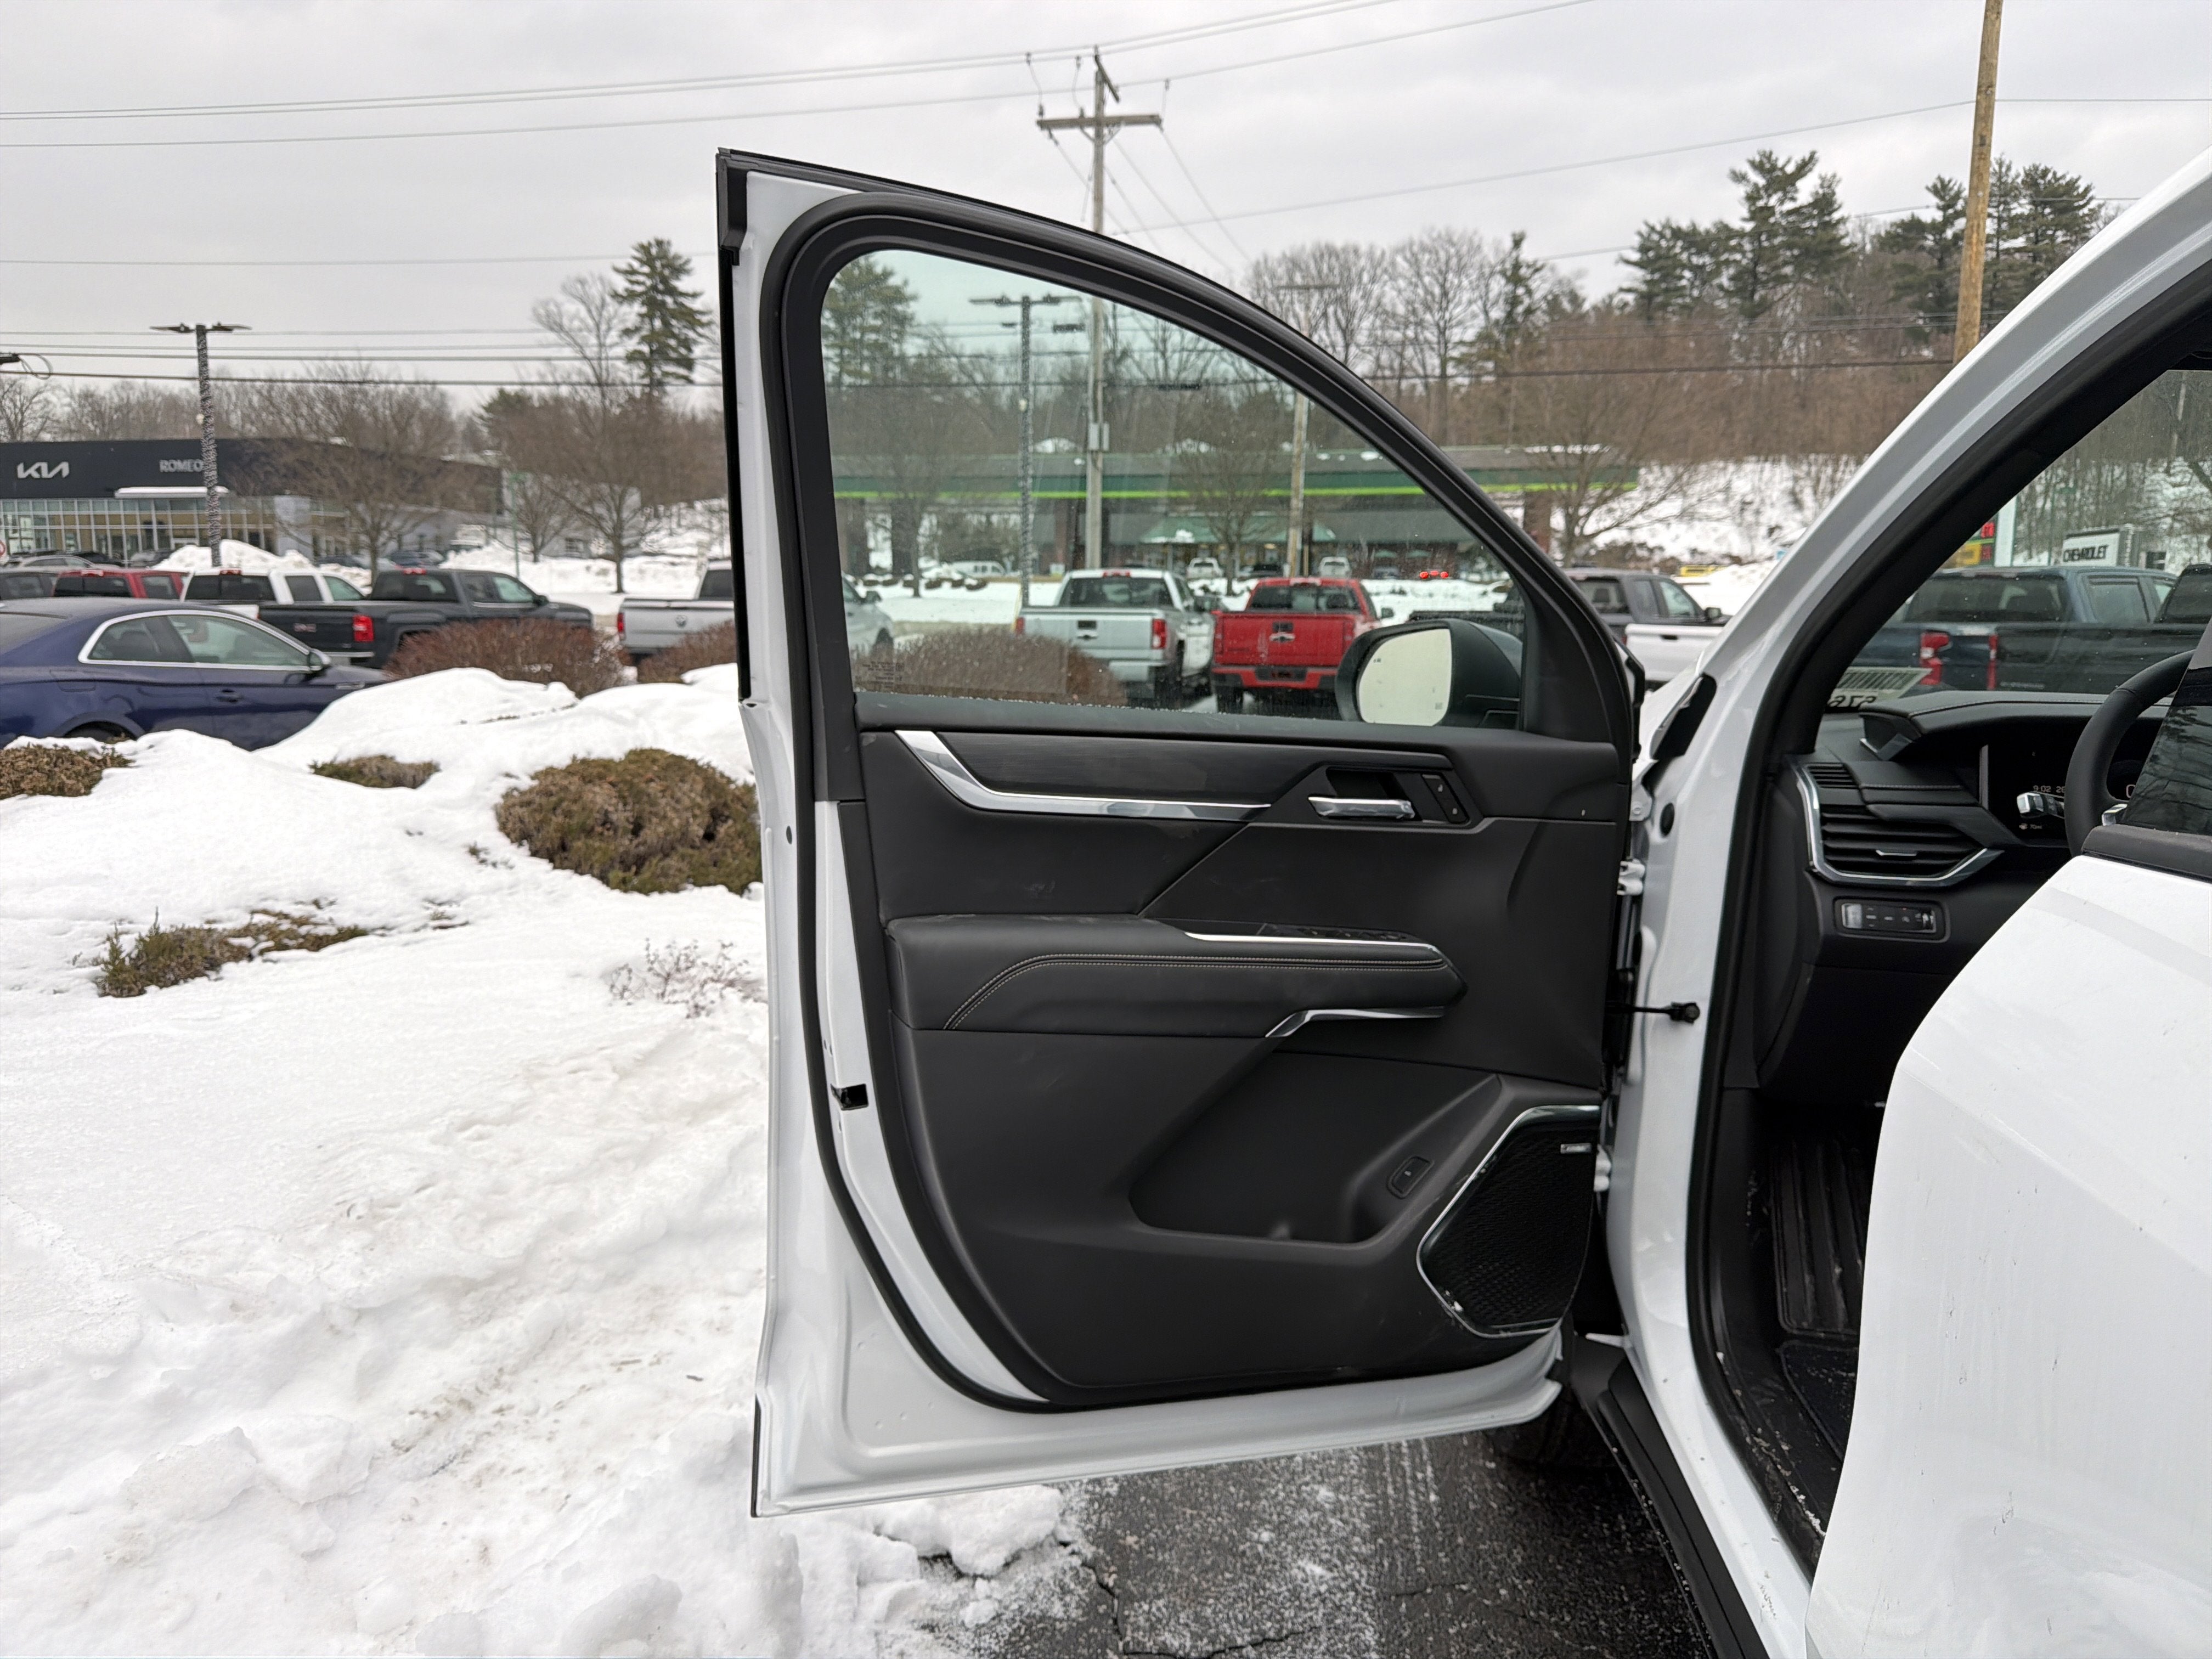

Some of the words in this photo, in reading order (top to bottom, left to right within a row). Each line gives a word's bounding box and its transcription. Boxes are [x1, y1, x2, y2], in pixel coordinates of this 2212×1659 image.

[17, 461, 70, 479] KIA
[159, 459, 203, 472] ROMEO
[2063, 544, 2108, 562] CHEVROLET
